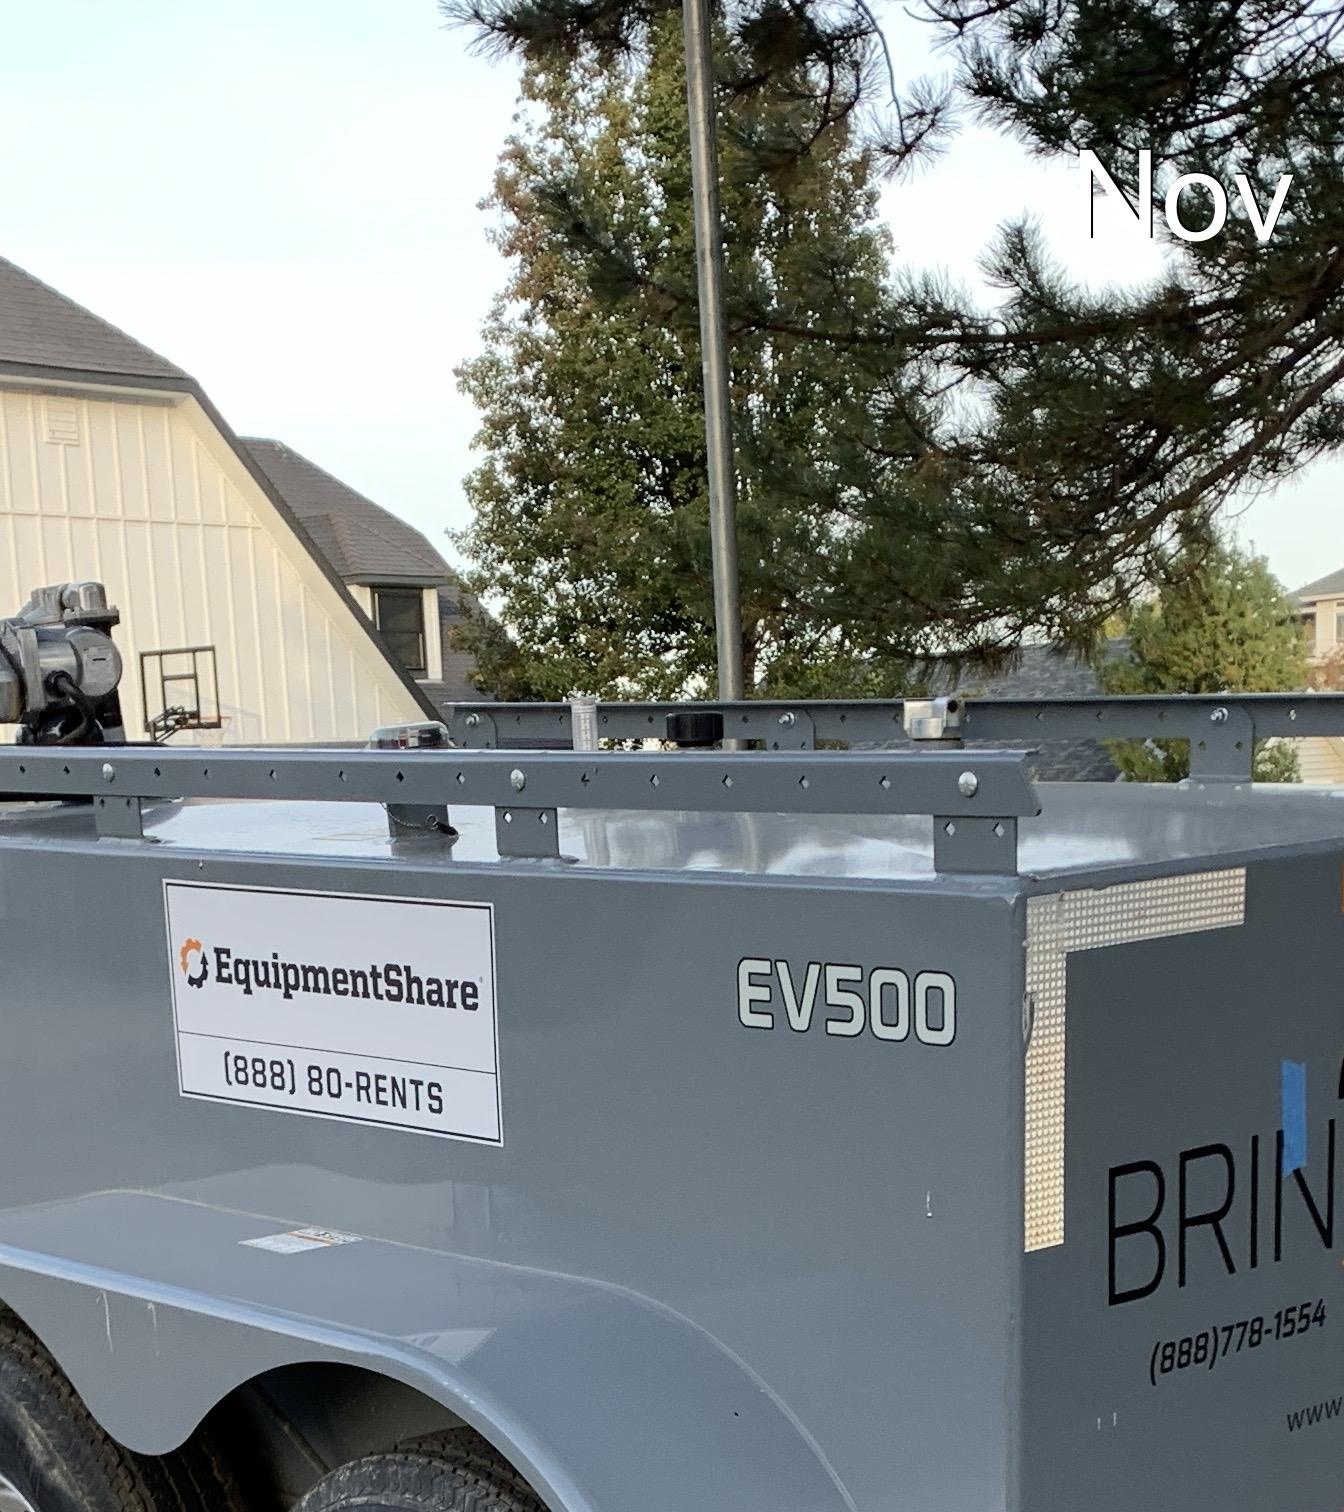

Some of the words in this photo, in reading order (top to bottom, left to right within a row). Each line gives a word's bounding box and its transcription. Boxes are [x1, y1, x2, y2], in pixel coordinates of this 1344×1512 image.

[213, 946, 479, 1011] EquipmentShare
[737, 957, 956, 1047] EV500
[224, 1051, 296, 1095] (888)
[306, 1065, 444, 1114] 80-RENTS
[1150, 1298, 1328, 1386] (888)778-1554
